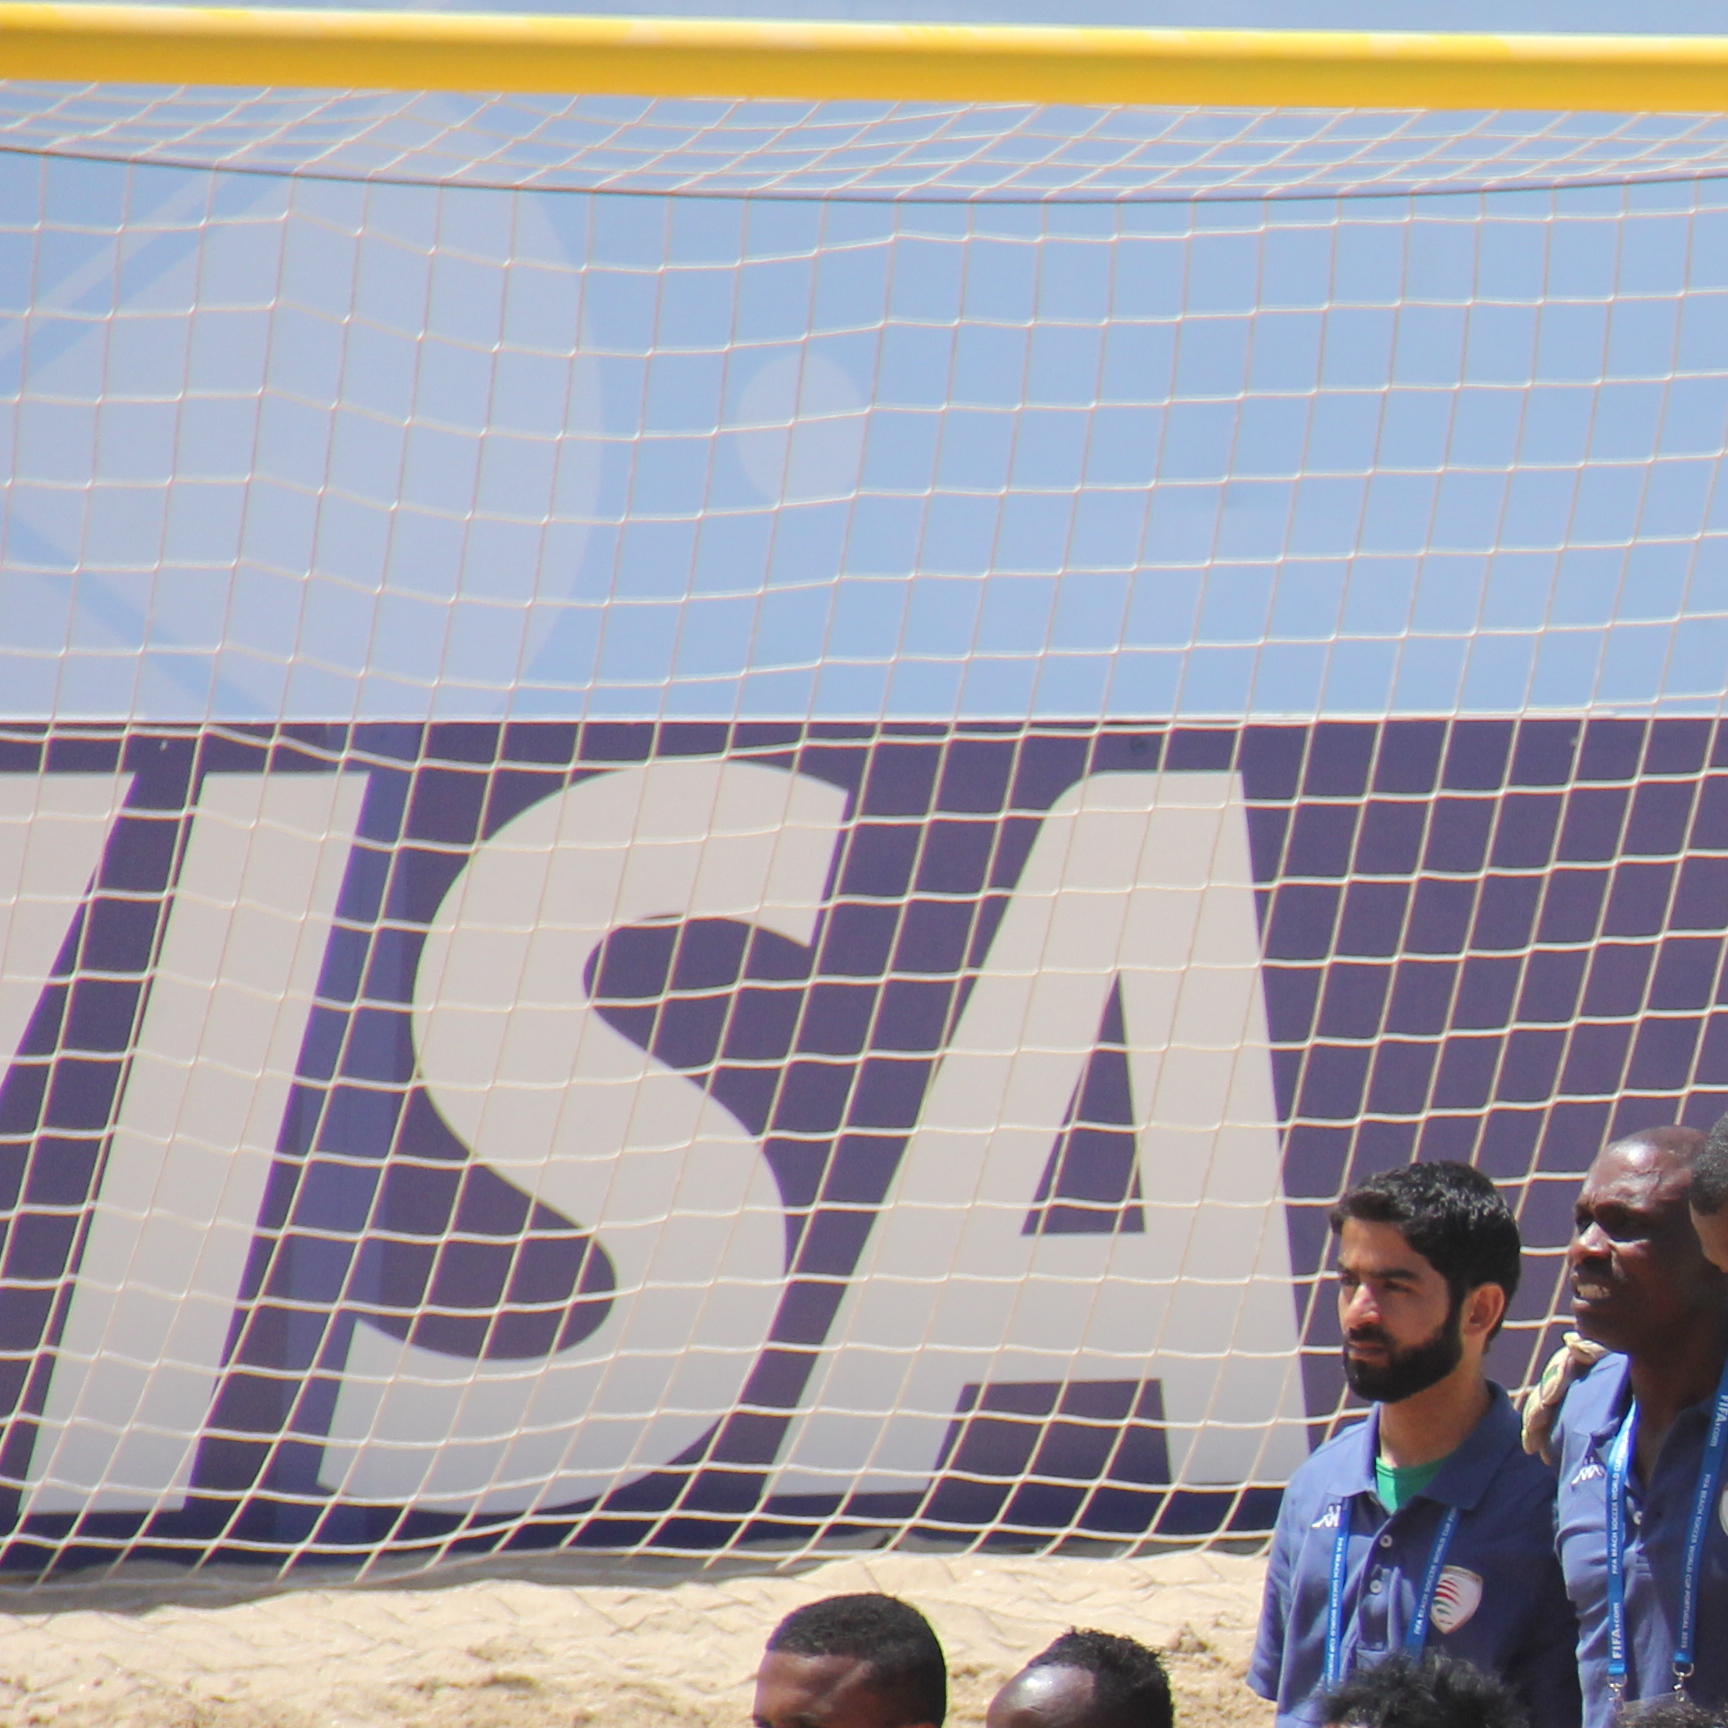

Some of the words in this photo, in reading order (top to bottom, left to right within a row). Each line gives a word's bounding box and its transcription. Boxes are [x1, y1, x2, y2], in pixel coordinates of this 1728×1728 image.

[1702, 1473, 1711, 1489] FIFA
[1336, 1536, 1344, 1553] FIFA
[1413, 1619, 1423, 1635] FIFA
